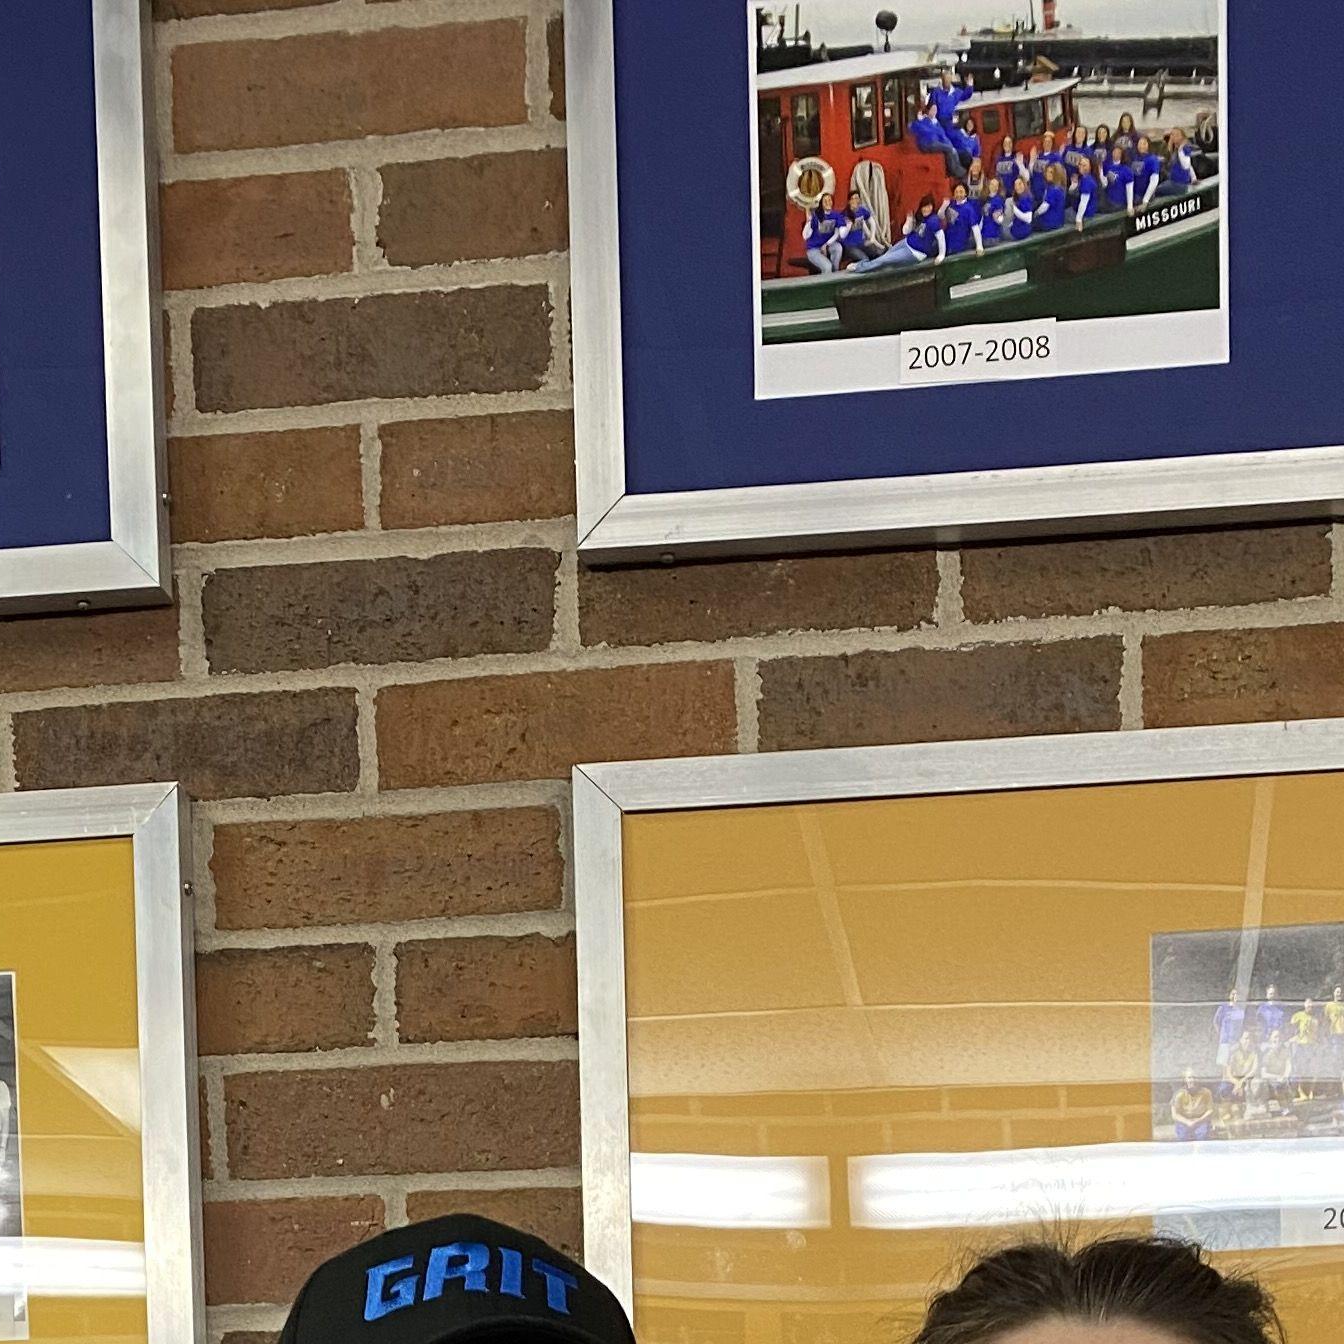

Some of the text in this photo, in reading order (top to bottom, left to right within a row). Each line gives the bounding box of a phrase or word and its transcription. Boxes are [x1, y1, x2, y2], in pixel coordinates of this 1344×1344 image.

[1135, 196, 1201, 231] MISSOURI
[908, 335, 1051, 370] 2007-2008
[363, 1241, 579, 1321] GRIT
